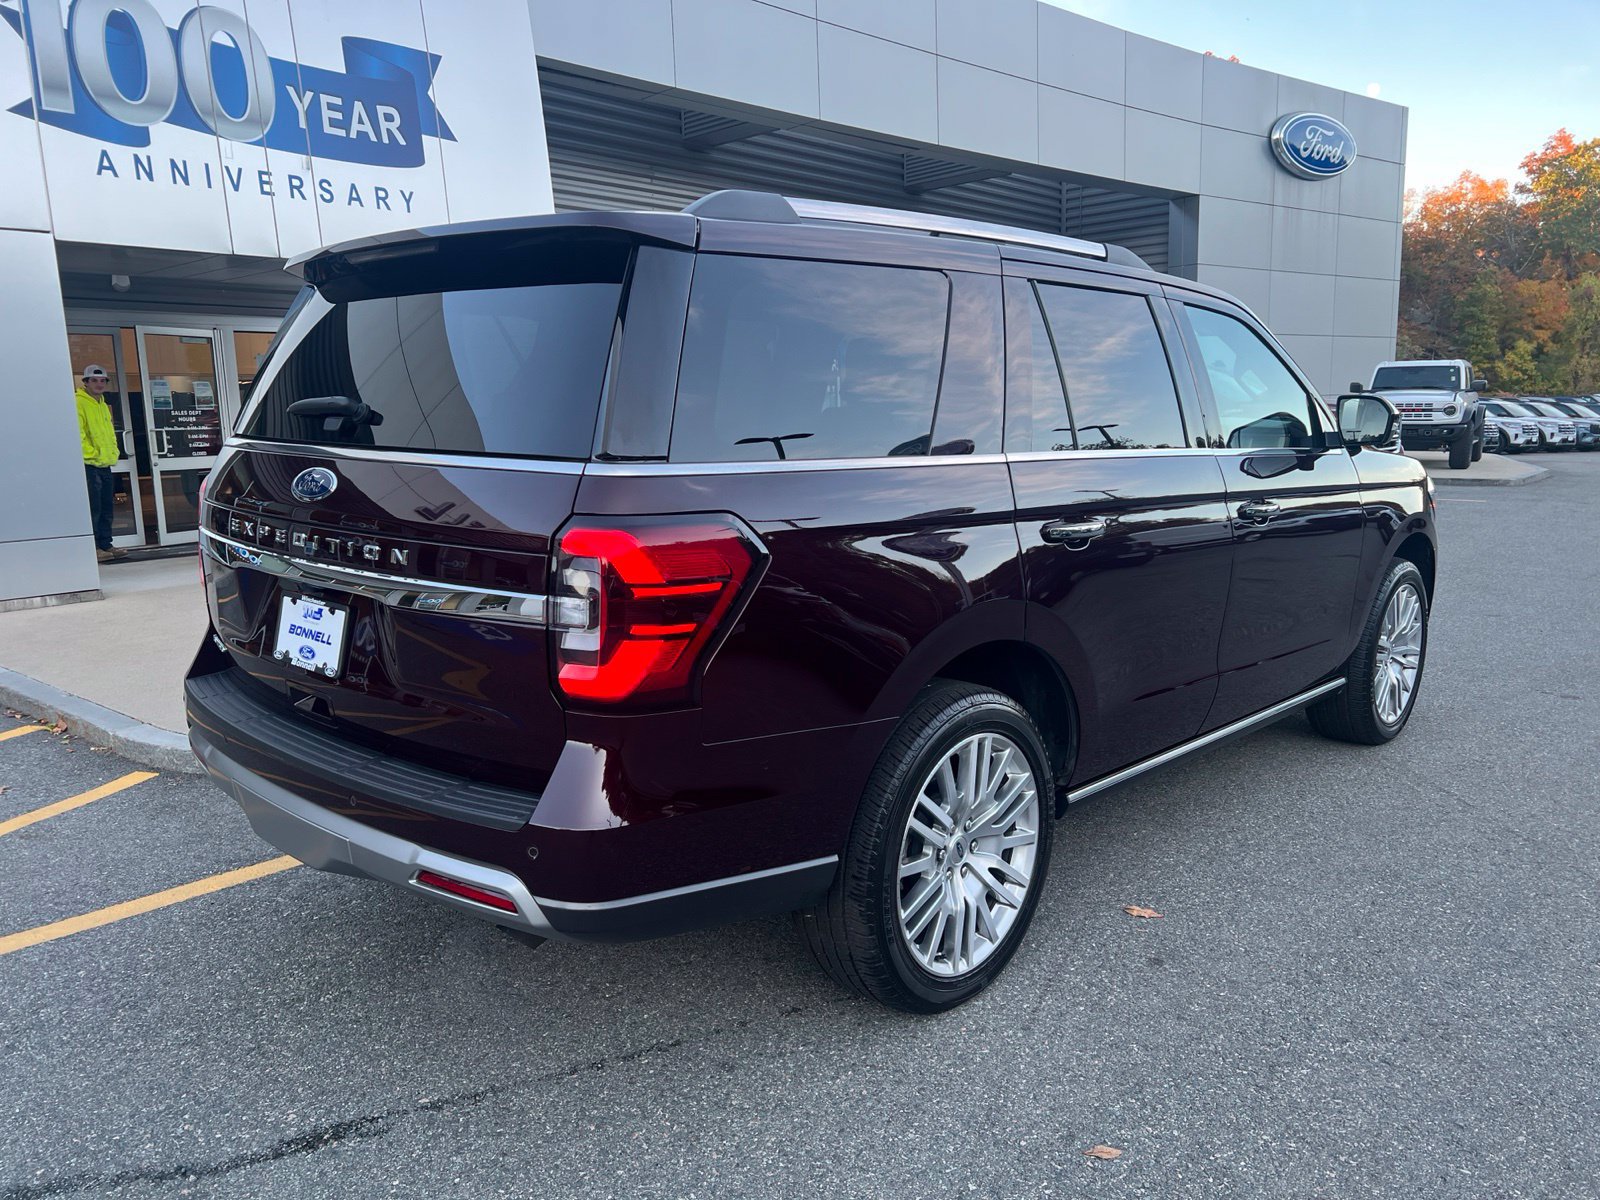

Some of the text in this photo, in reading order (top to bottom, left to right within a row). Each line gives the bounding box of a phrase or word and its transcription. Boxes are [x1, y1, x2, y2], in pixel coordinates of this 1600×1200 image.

[25, 0, 276, 142] 100
[285, 84, 407, 146] YEAR
[1300, 125, 1344, 164] Ford
[96, 148, 414, 214] ANNIVERSARY
[231, 518, 409, 566] EXPEDITION
[288, 623, 333, 646] BONNELL
[290, 657, 317, 672] Bonnell
